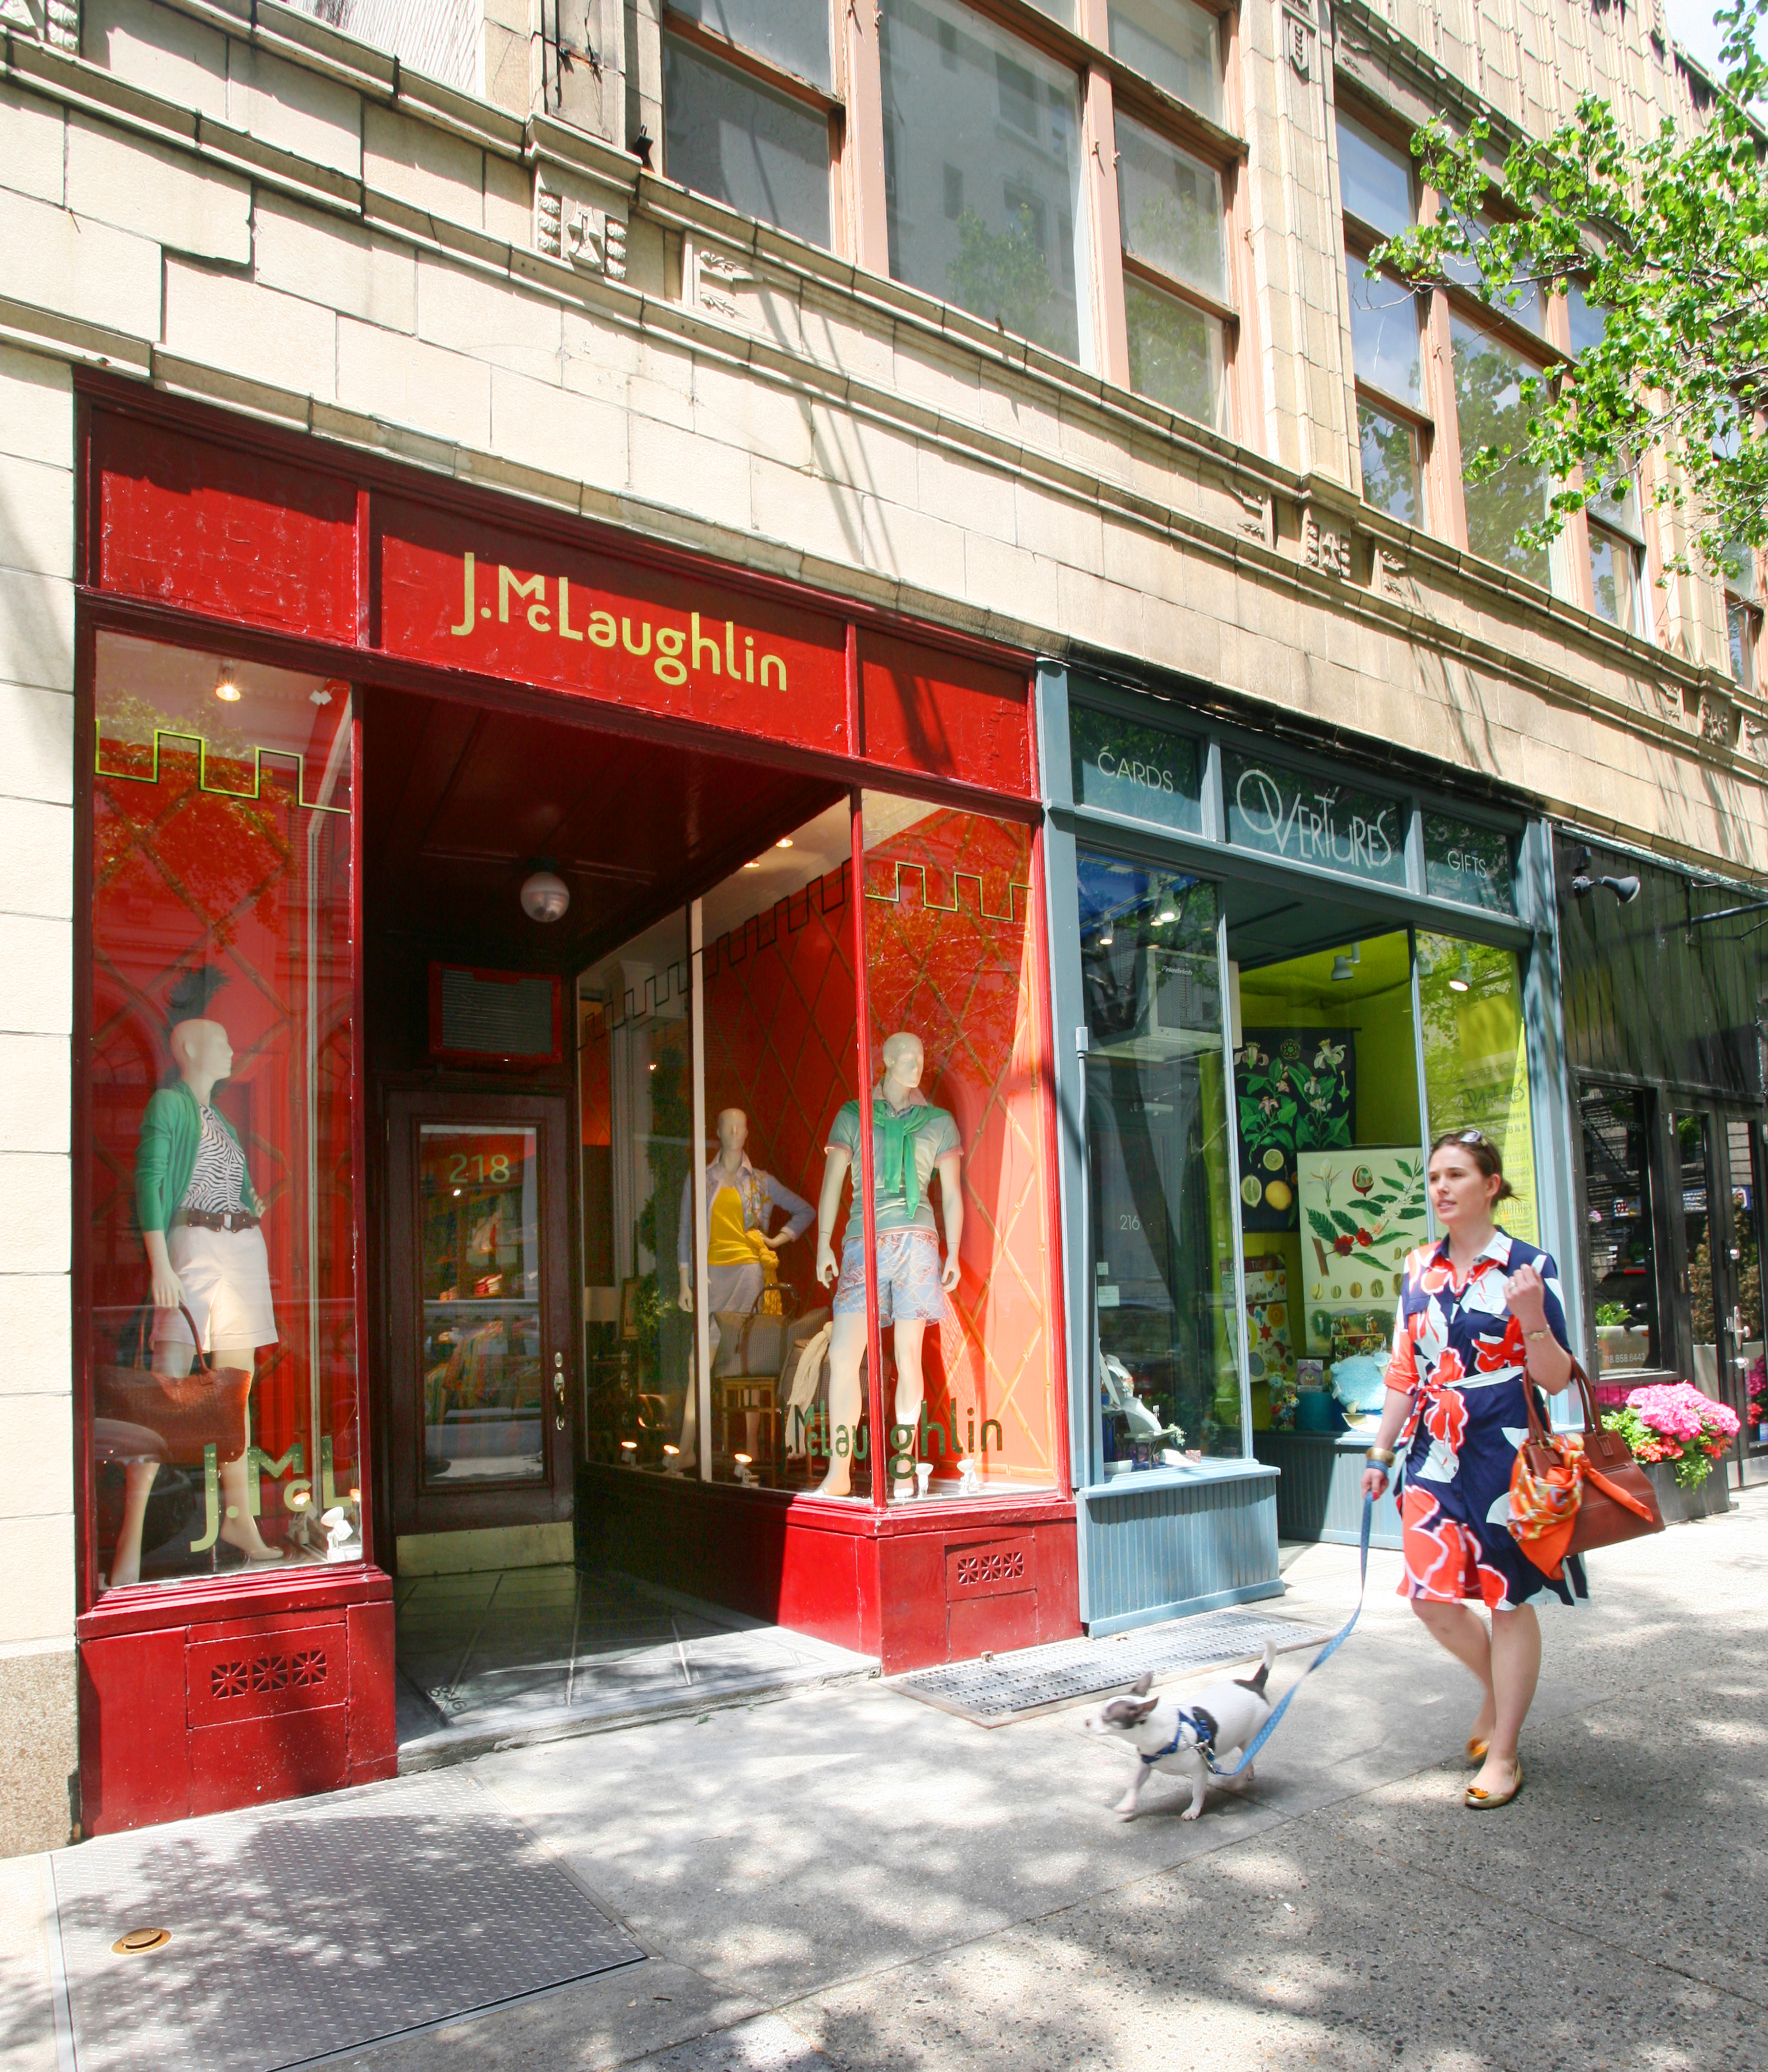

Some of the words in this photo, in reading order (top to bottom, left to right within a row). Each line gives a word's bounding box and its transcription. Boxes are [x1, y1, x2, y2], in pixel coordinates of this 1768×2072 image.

[1098, 752, 1173, 794] CARDS
[1236, 769, 1392, 869] OVERTURES
[1447, 851, 1487, 878] GIFTS
[1161, 965, 1192, 976] Friedrich
[449, 1154, 510, 1183] 218
[1119, 1214, 1140, 1231] 216
[1603, 1353, 1645, 1363] 718.858.6443
